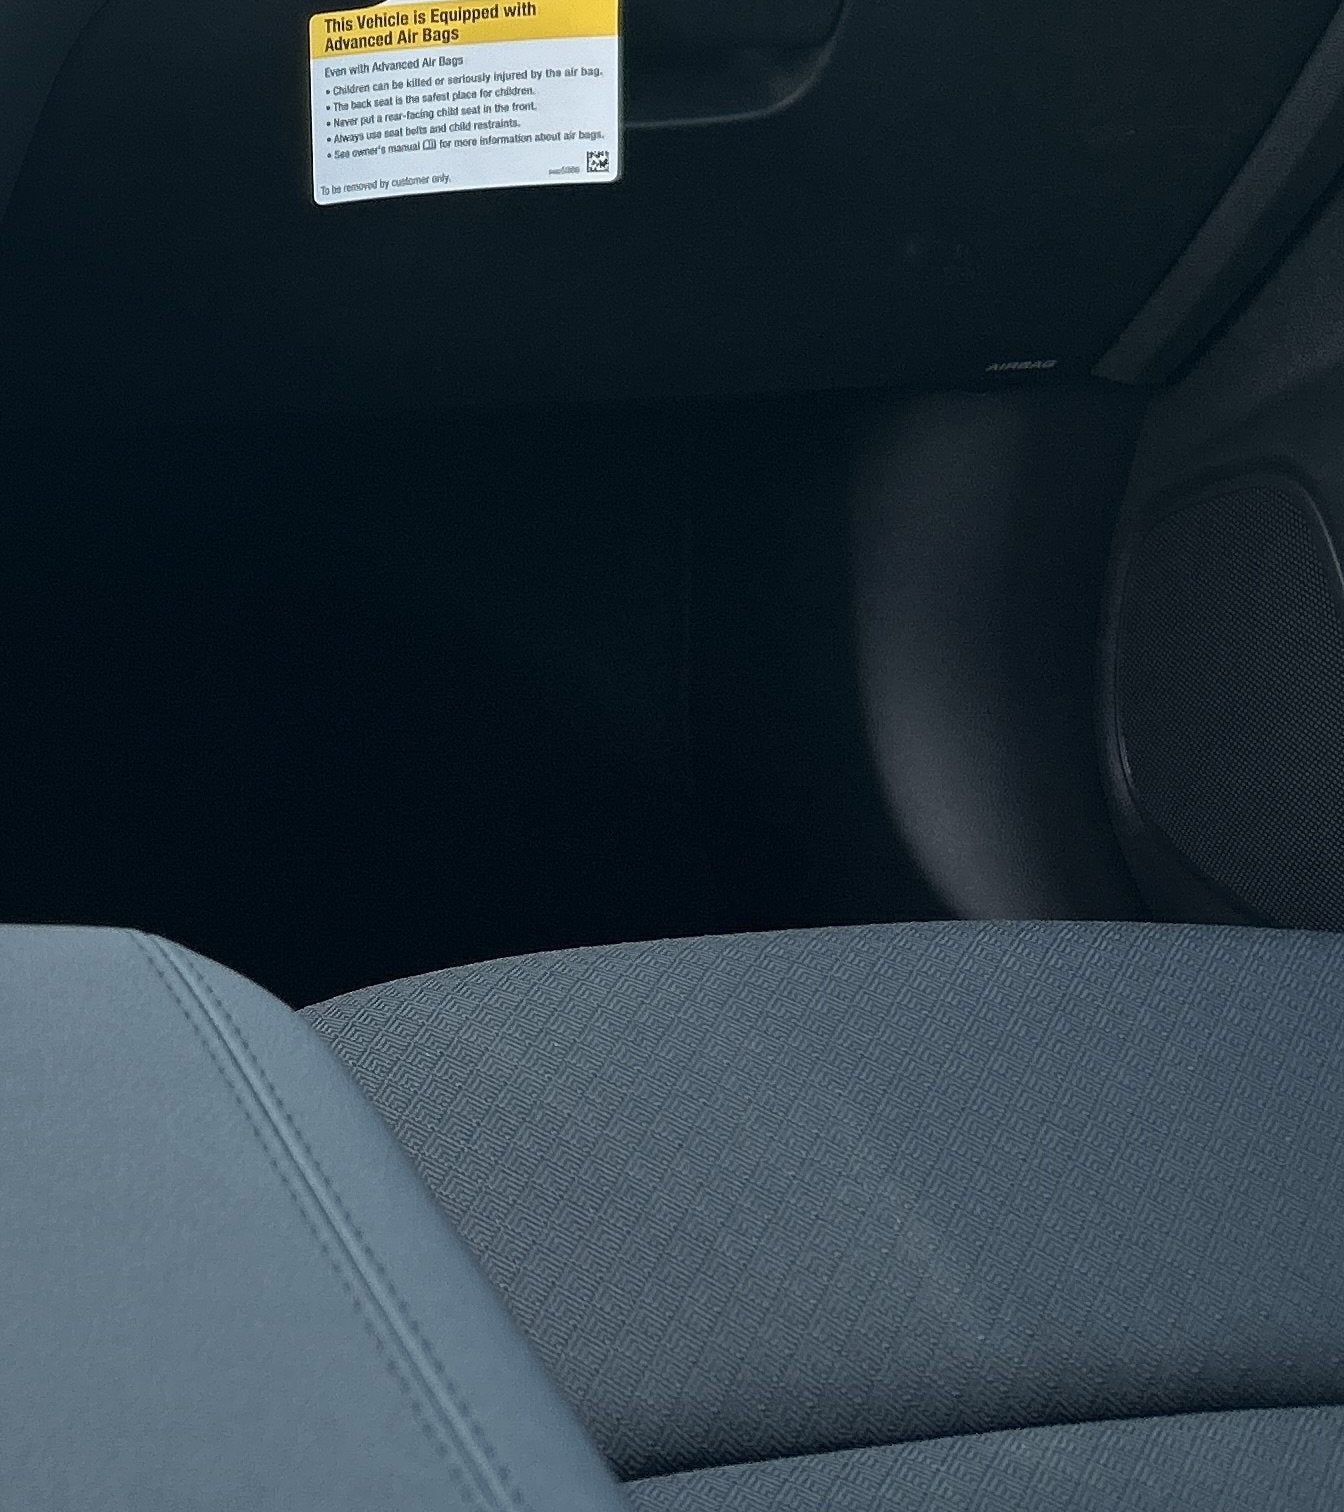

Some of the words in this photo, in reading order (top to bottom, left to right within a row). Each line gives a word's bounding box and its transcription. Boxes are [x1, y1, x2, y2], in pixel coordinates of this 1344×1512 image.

[325, 17, 353, 33] This
[357, 12, 409, 29] Vehicle
[413, 10, 426, 25] is
[430, 4, 499, 24] Equipped
[503, 1, 537, 17] with
[324, 31, 393, 52] Advanced
[397, 29, 419, 44] Air
[422, 28, 459, 43] Bags
[325, 67, 347, 78] Even
[349, 64, 370, 75] with
[372, 58, 419, 72] Advanced
[422, 57, 436, 68] Air
[439, 56, 464, 67] Bags
[333, 84, 370, 96] Children
[373, 82, 389, 92] can
[392, 80, 403, 89] be
[406, 77, 432, 88] killed
[435, 78, 445, 86] or
[447, 72, 490, 85] seriously
[494, 70, 528, 83] injured
[531, 69, 542, 80] by
[546, 68, 562, 78] the
[565, 67, 578, 77] air
[334, 102, 349, 112] The
[351, 99, 372, 109] back
[374, 97, 393, 108] seat
[395, 96, 403, 105] is
[406, 94, 420, 104] the
[422, 91, 450, 103] safest
[452, 89, 477, 101] place
[480, 87, 492, 99] for
[334, 117, 357, 128] Never
[361, 115, 375, 126] put
[377, 115, 382, 123] a
[385, 108, 434, 122] rear-facing
[437, 106, 459, 117] child
[461, 105, 481, 116] seat
[483, 103, 492, 114] in
[494, 103, 509, 113] the
[334, 133, 364, 144] Always
[366, 131, 382, 140] use
[384, 128, 403, 138] seat
[406, 125, 427, 136] belts
[430, 123, 447, 134] and
[449, 121, 471, 132] child
[334, 149, 350, 160] See
[352, 145, 386, 158] owner's
[388, 141, 420, 153] manual
[439, 139, 451, 149] for
[454, 138, 477, 148] more
[480, 133, 532, 145] information
[535, 131, 561, 143] about
[564, 130, 577, 140] air
[985, 359, 1058, 372] AIRBAG
